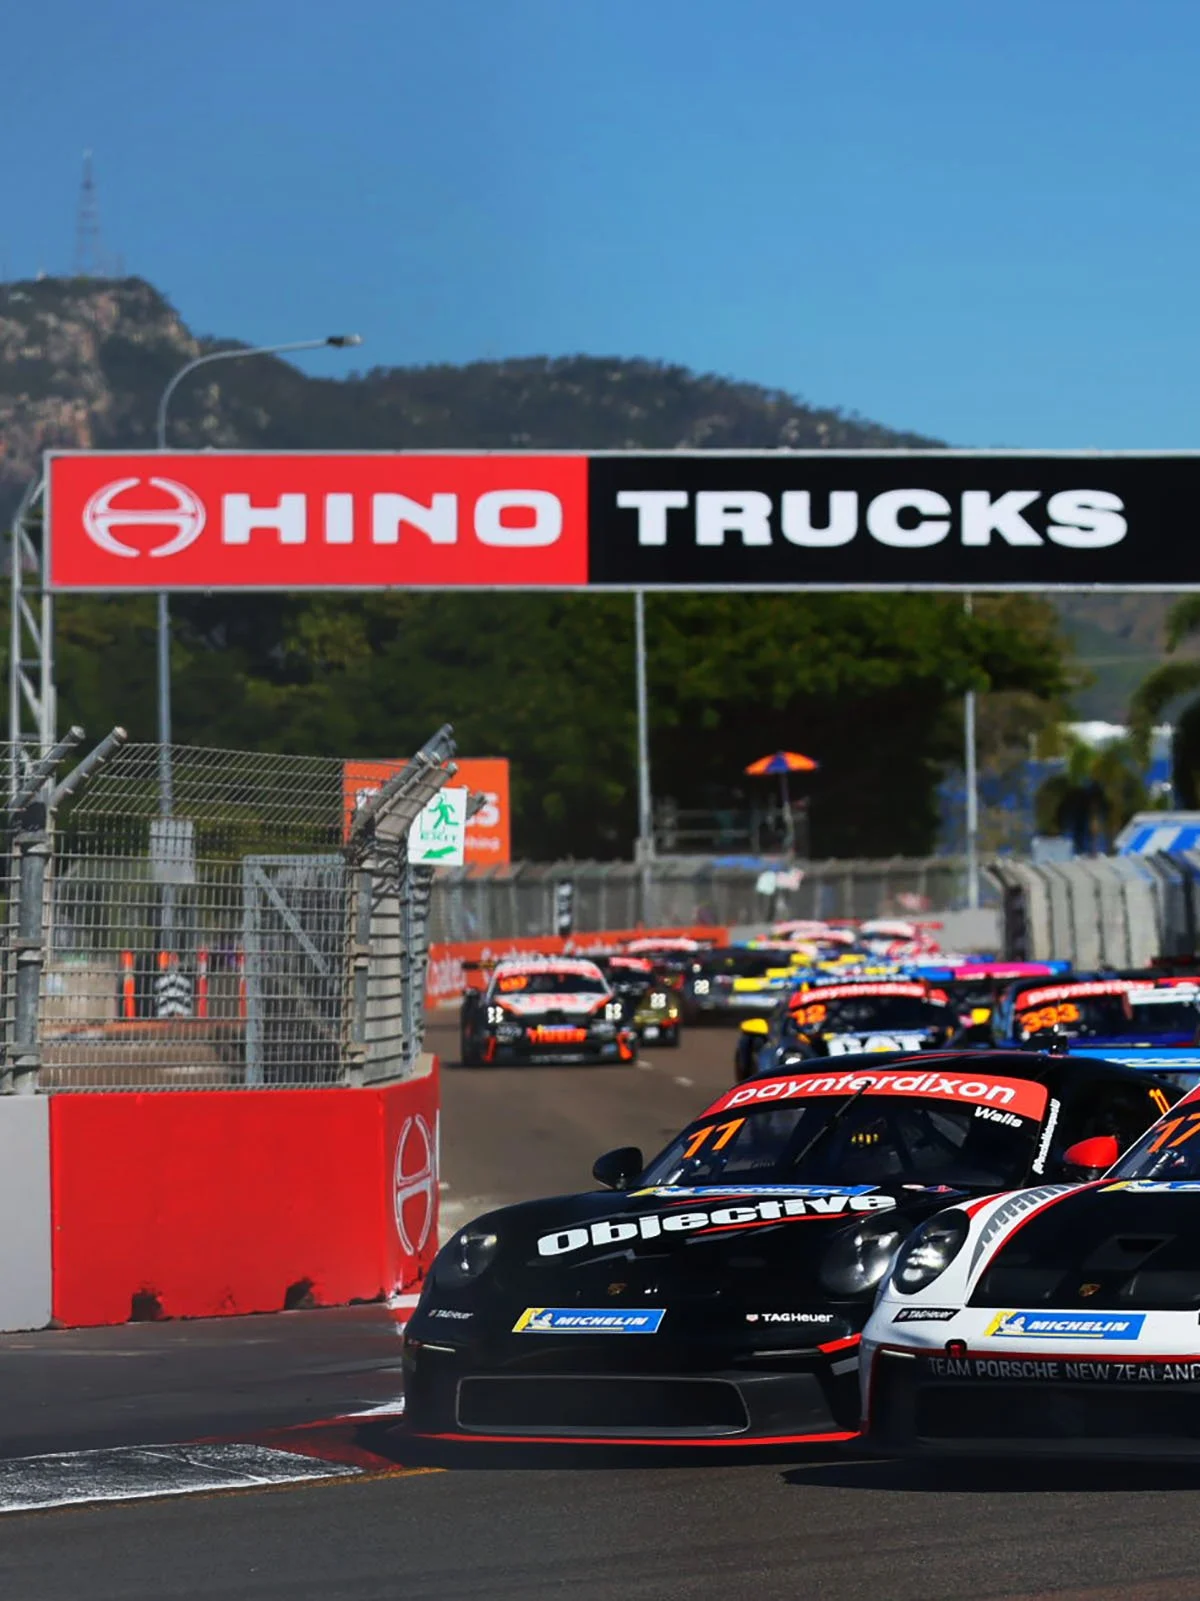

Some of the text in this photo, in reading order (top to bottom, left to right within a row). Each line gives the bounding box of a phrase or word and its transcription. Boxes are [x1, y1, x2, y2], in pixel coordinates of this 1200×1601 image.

[222, 488, 1128, 548] HINO TRUCKS
[1019, 1002, 1080, 1034] 333
[726, 1073, 1016, 1109] paynterdixon
[975, 1105, 1023, 1129] Walls
[683, 1117, 747, 1159] 11
[555, 1314, 650, 1327] MICHELIN
[1028, 1320, 1129, 1332] MICHELIN
[929, 1356, 973, 1378] TEAM
[976, 1358, 1061, 1379] PORSCHE
[1067, 1360, 1112, 1380] NEW
